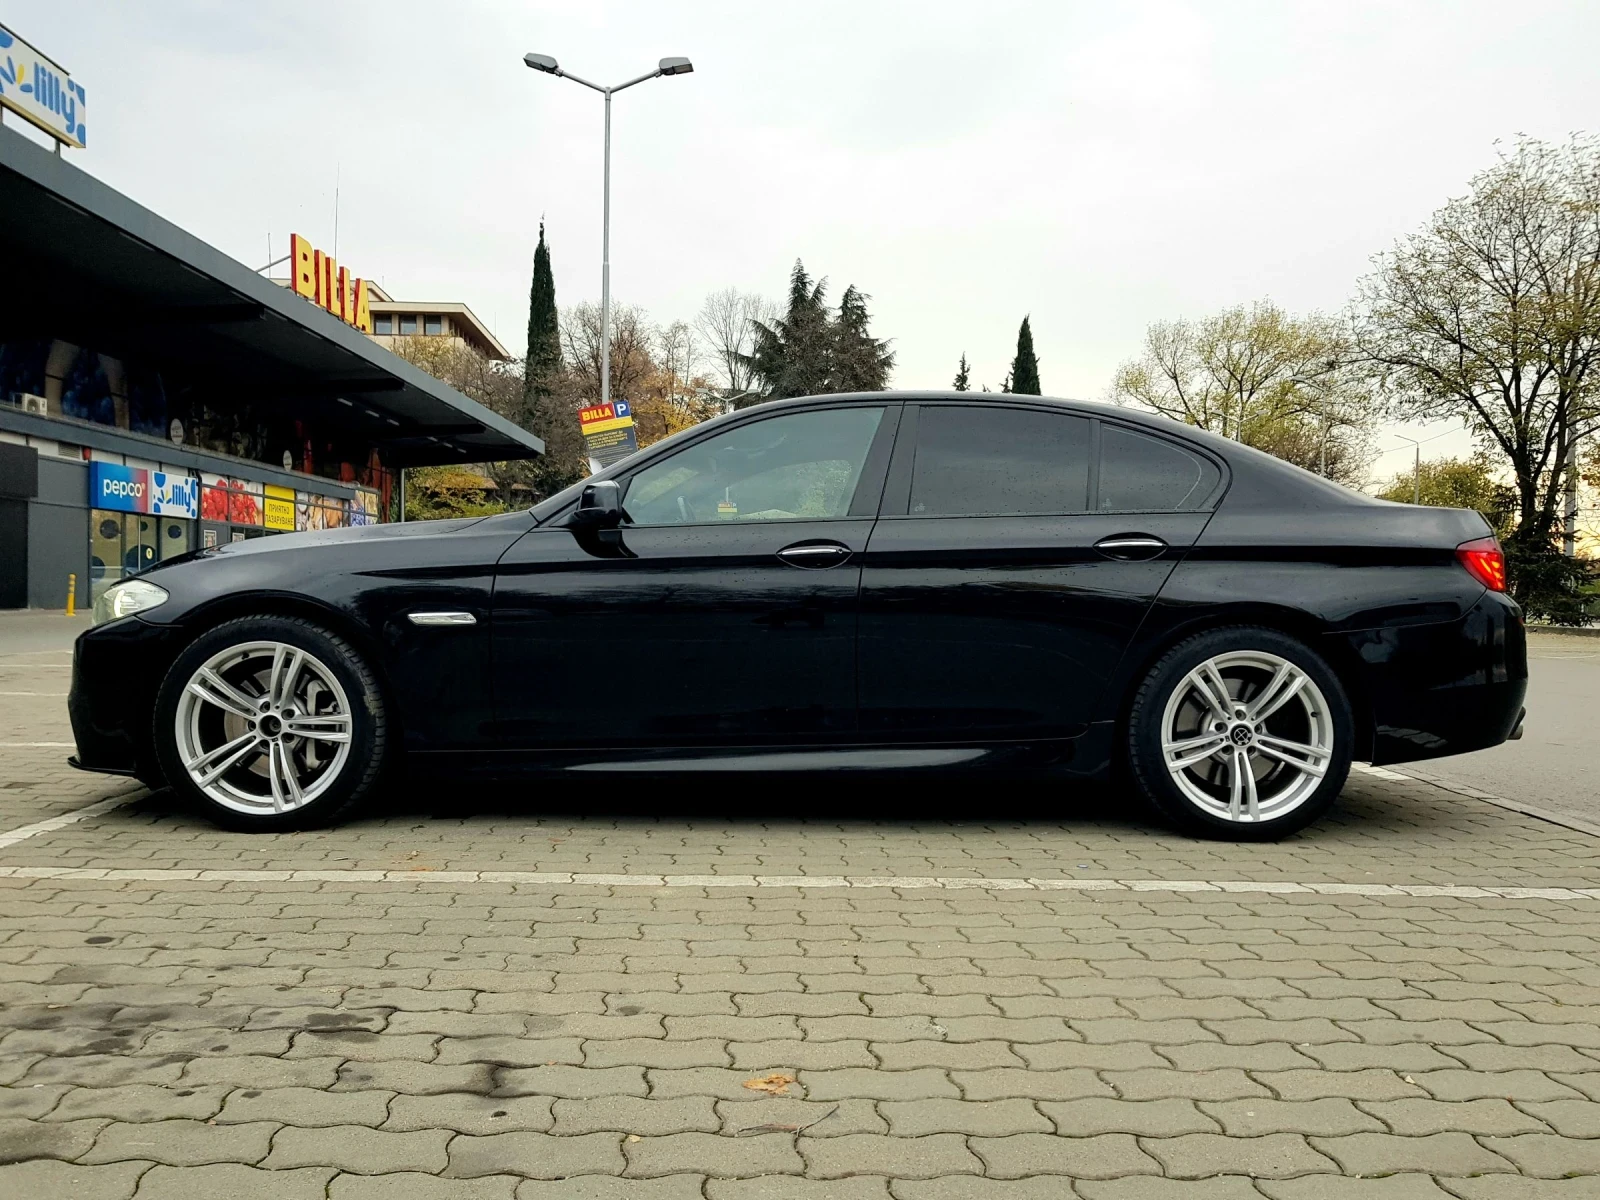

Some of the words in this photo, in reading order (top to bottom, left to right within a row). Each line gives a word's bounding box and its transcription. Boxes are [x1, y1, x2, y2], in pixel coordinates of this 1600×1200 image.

[34, 61, 75, 133] lilly
[290, 233, 371, 335] BILLA
[581, 407, 612, 421] BILLA
[616, 403, 627, 416] P
[103, 479, 142, 498] pepco
[172, 484, 191, 513] lilly
[268, 503, 290, 515] ПРИЯТНО
